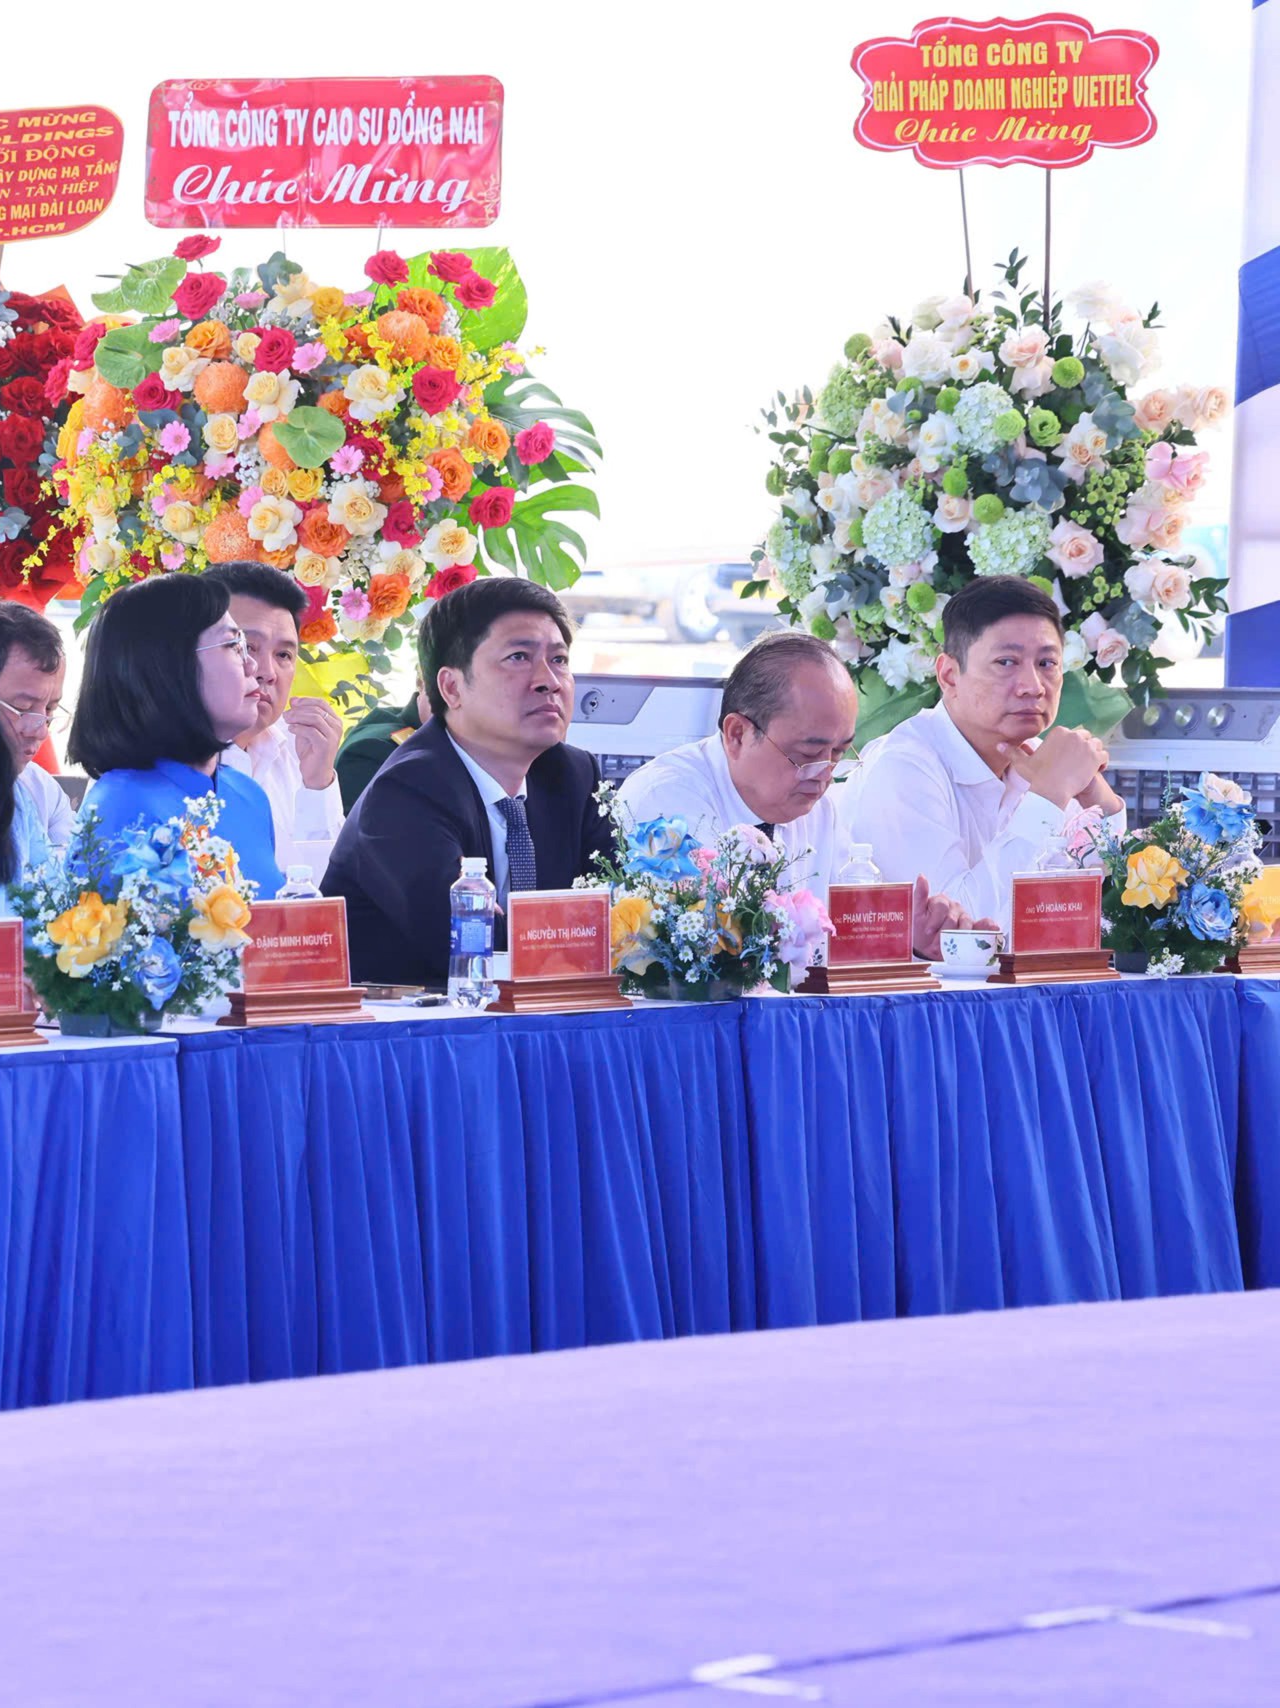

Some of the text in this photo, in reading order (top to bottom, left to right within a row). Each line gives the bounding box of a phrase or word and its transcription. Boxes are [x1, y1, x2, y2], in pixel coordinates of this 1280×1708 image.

[920, 36, 1083, 68] TỔNG CÔNG TY
[873, 70, 1135, 115] GIẢI PHÁP DOANH NGHIỆP VIETTEL
[17, 112, 97, 128] MỪNG
[168, 90, 484, 148] TỔNG CÔNG TY CAO SU ĐỒNG NAI
[894, 116, 1094, 146] Chúc Mừng
[25, 144, 96, 163] ĐỘNG
[17, 167, 57, 183] DỰNG
[61, 165, 80, 180] HẠ
[25, 183, 58, 197] TÂN
[61, 179, 99, 195] HIỆP
[172, 163, 472, 213] Chúc Mừng
[11, 203, 36, 222] MẠI
[40, 198, 64, 217] ĐÀI
[68, 198, 105, 215] LOAN
[279, 935, 301, 947] MINH
